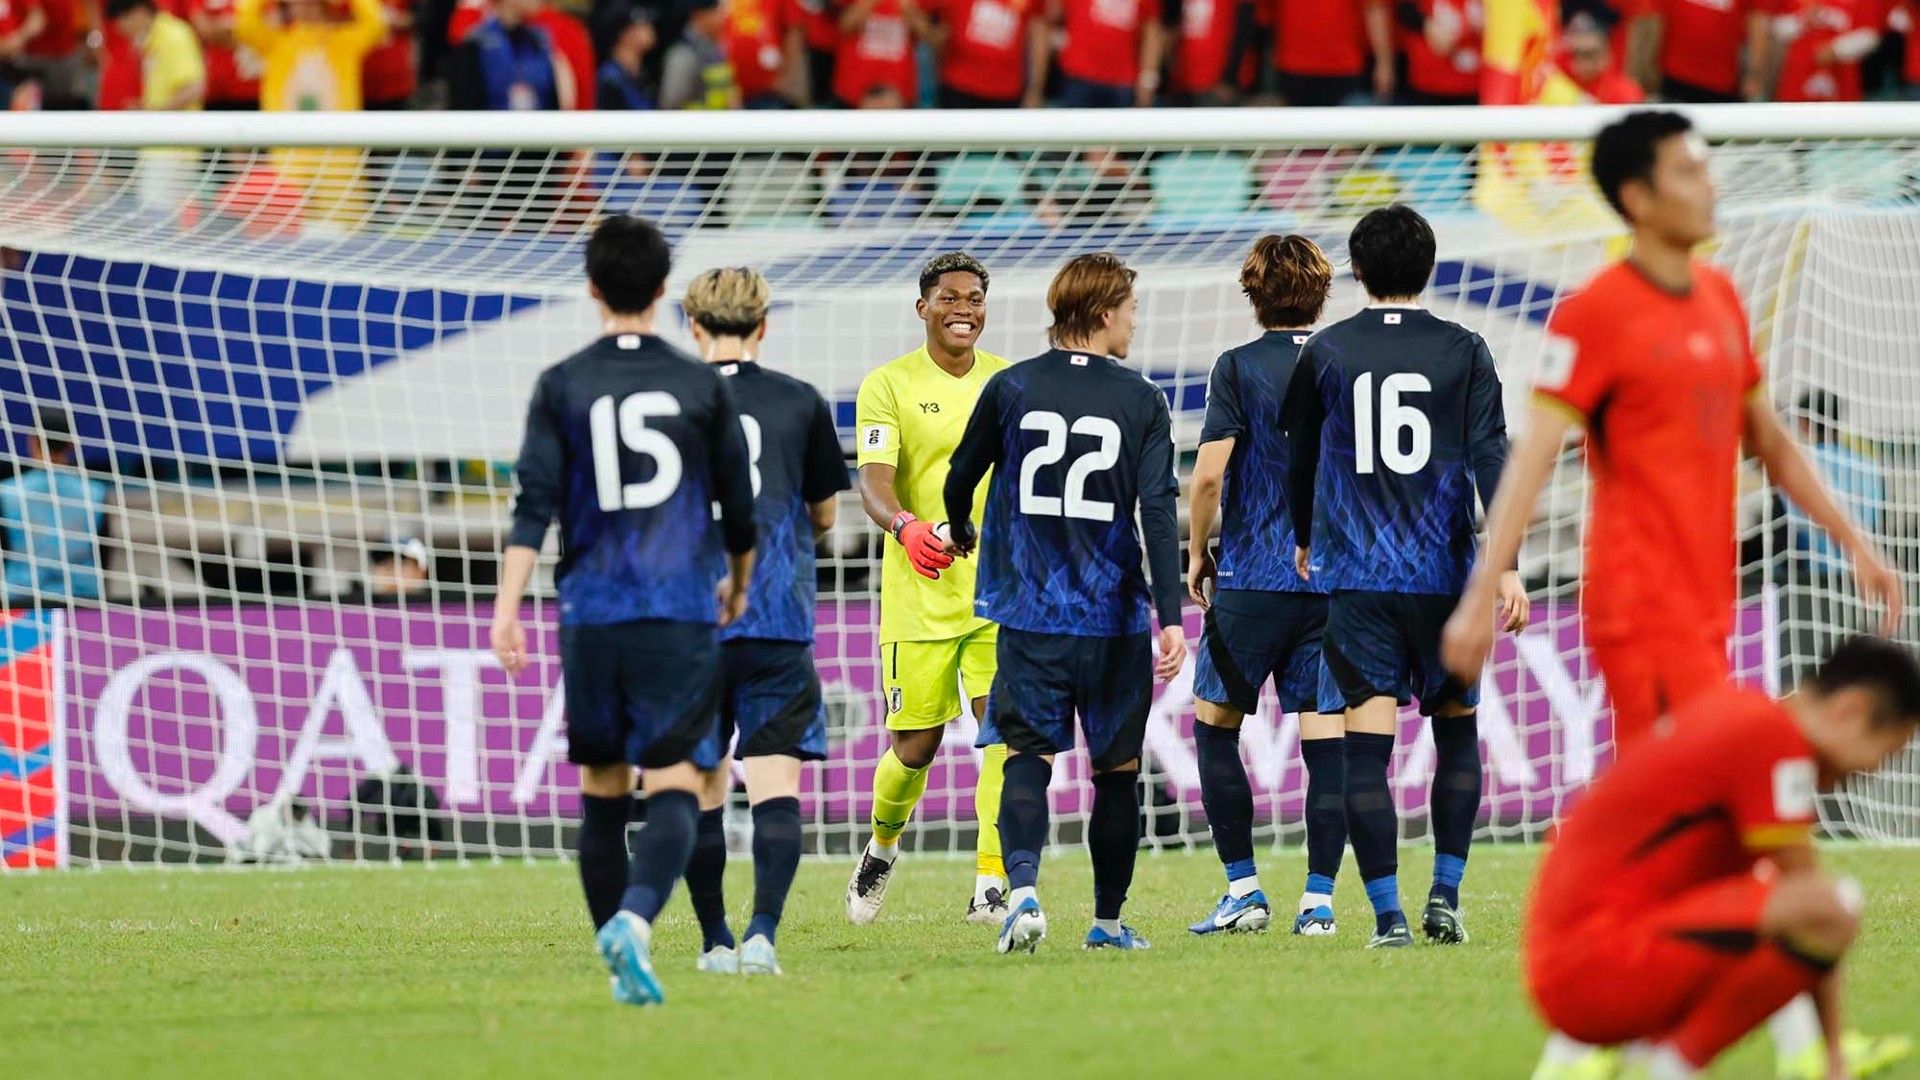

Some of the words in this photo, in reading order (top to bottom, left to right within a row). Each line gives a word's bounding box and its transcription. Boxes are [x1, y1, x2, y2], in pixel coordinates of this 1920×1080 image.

[589, 390, 683, 512] 15
[919, 402, 940, 414] Y-3
[1353, 371, 1432, 475] 16
[1019, 410, 1121, 522] 22
[92, 648, 752, 846] QAT
